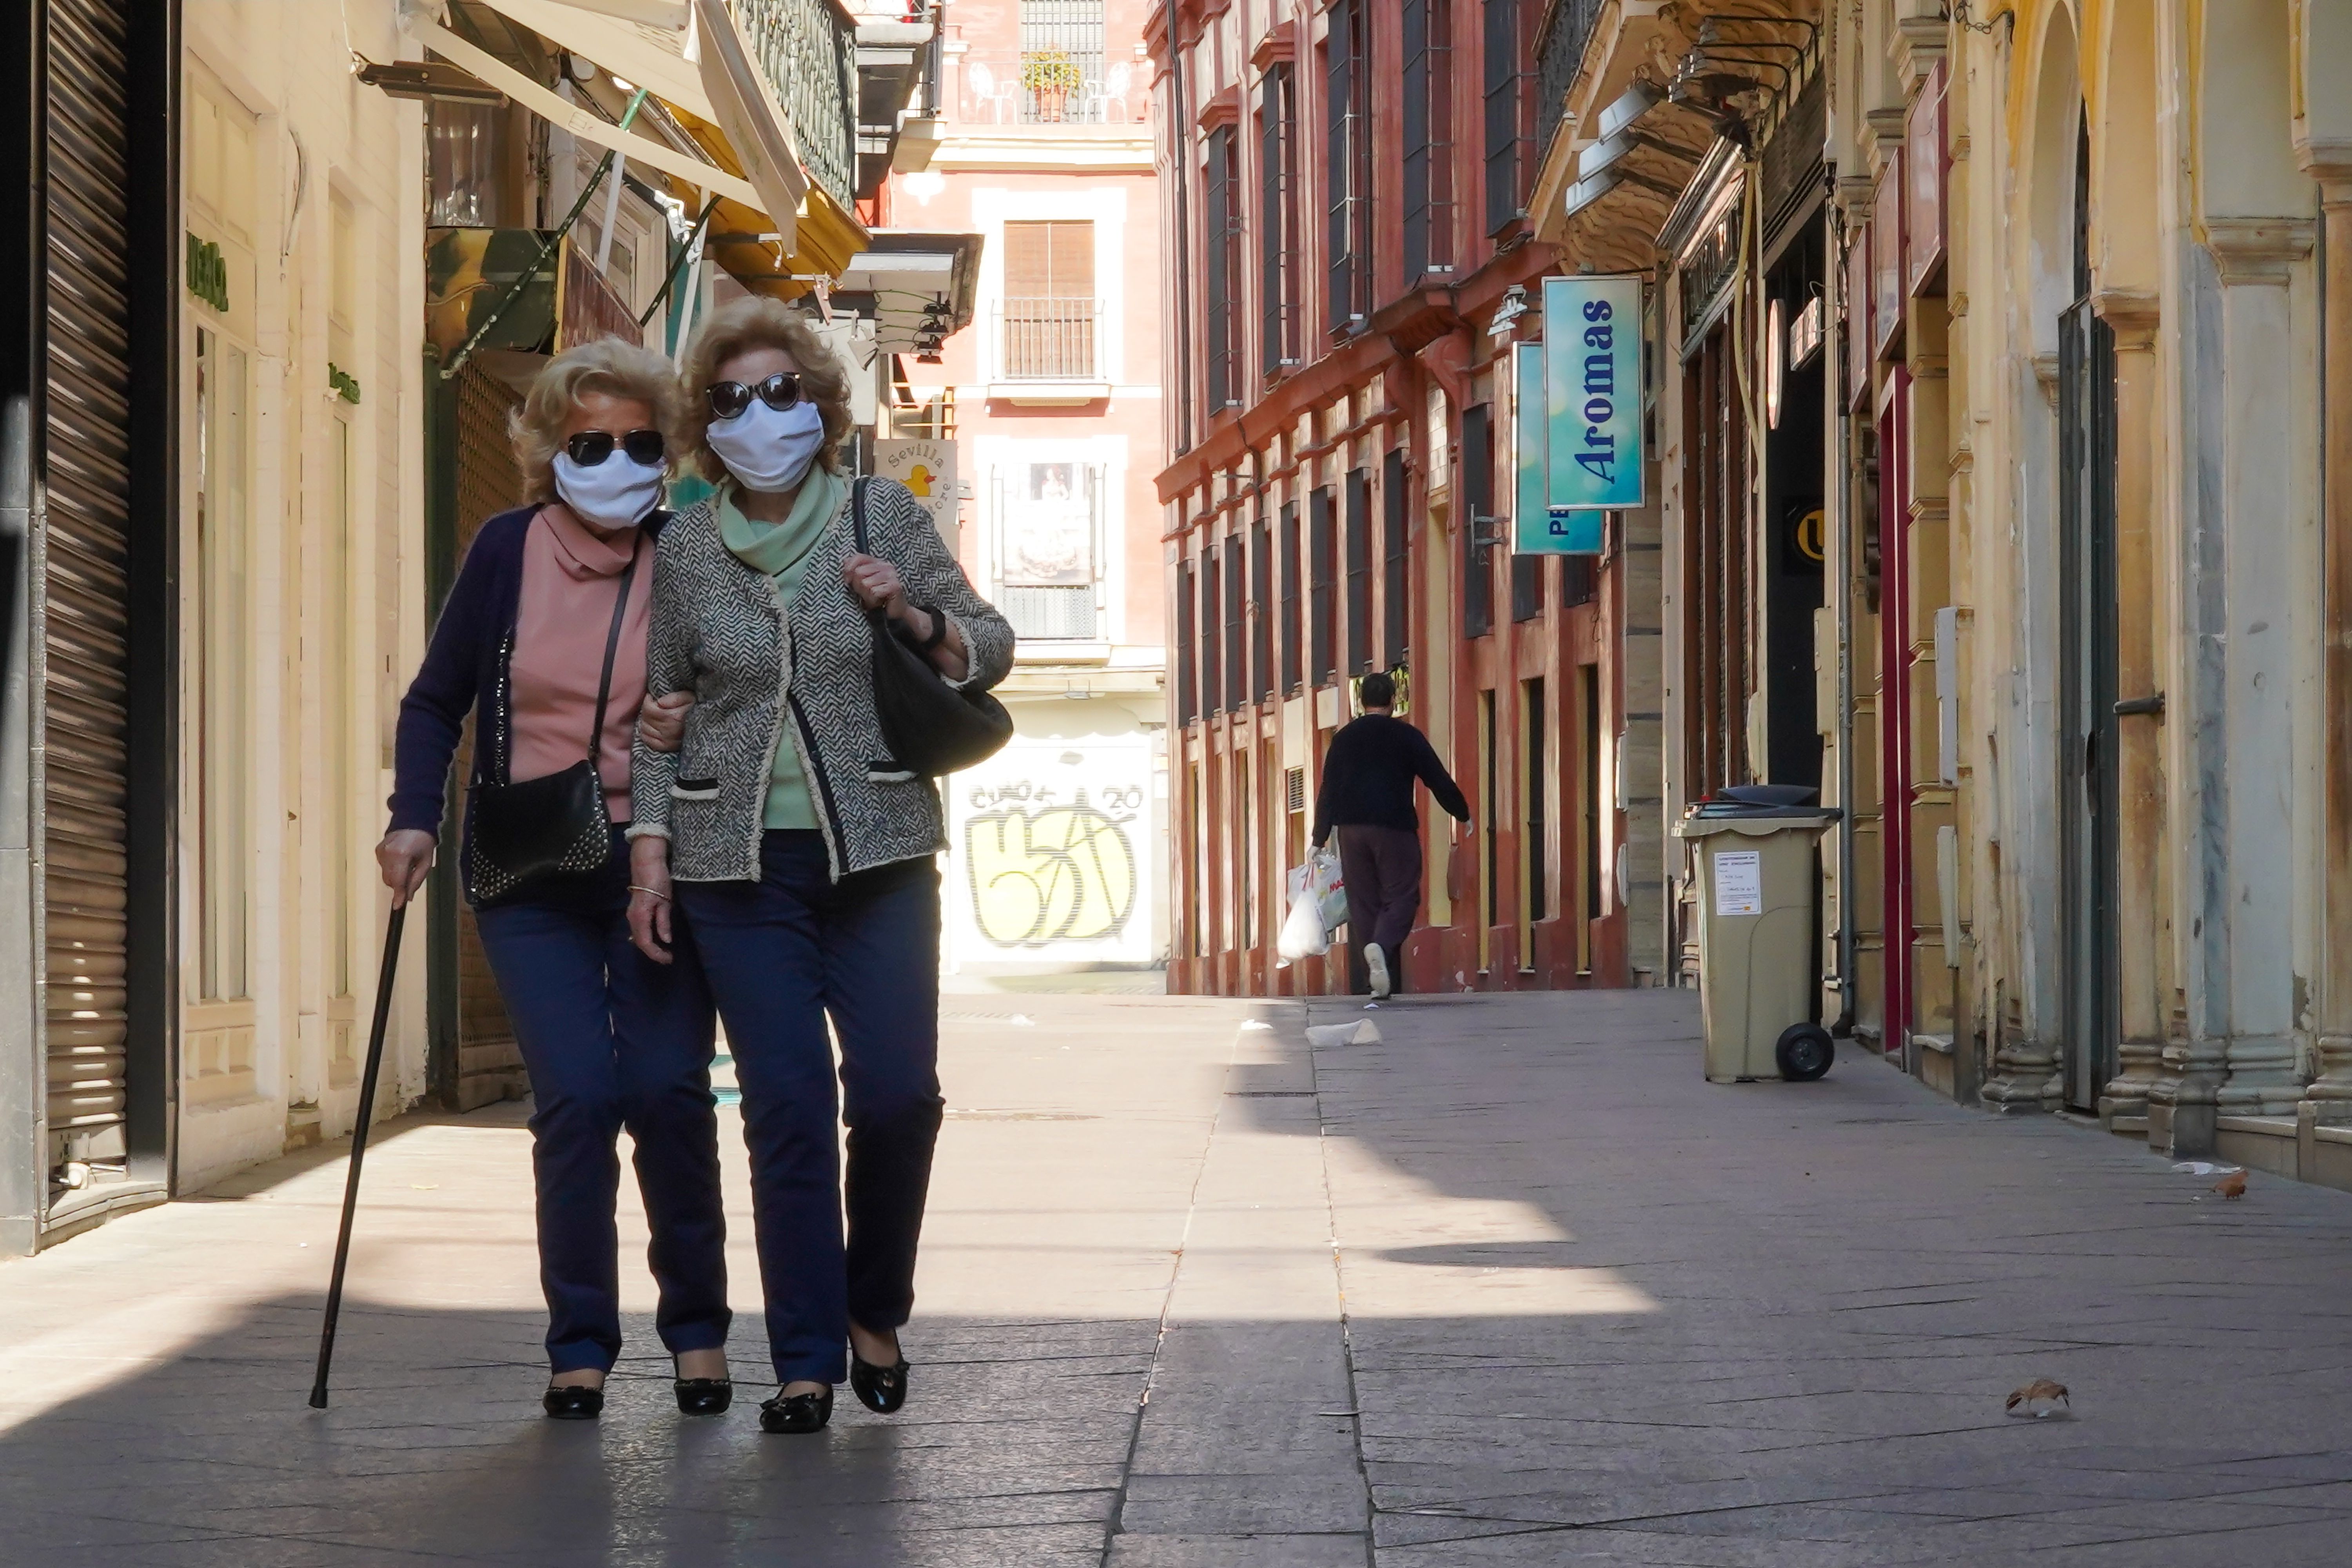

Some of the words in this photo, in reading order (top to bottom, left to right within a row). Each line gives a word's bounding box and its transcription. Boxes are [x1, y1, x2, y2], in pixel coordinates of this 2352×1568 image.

[1574, 299, 1615, 485] Aromas
[887, 443, 944, 469] Sevilla
[927, 483, 951, 515] tore
[1549, 510, 1569, 535] PE
